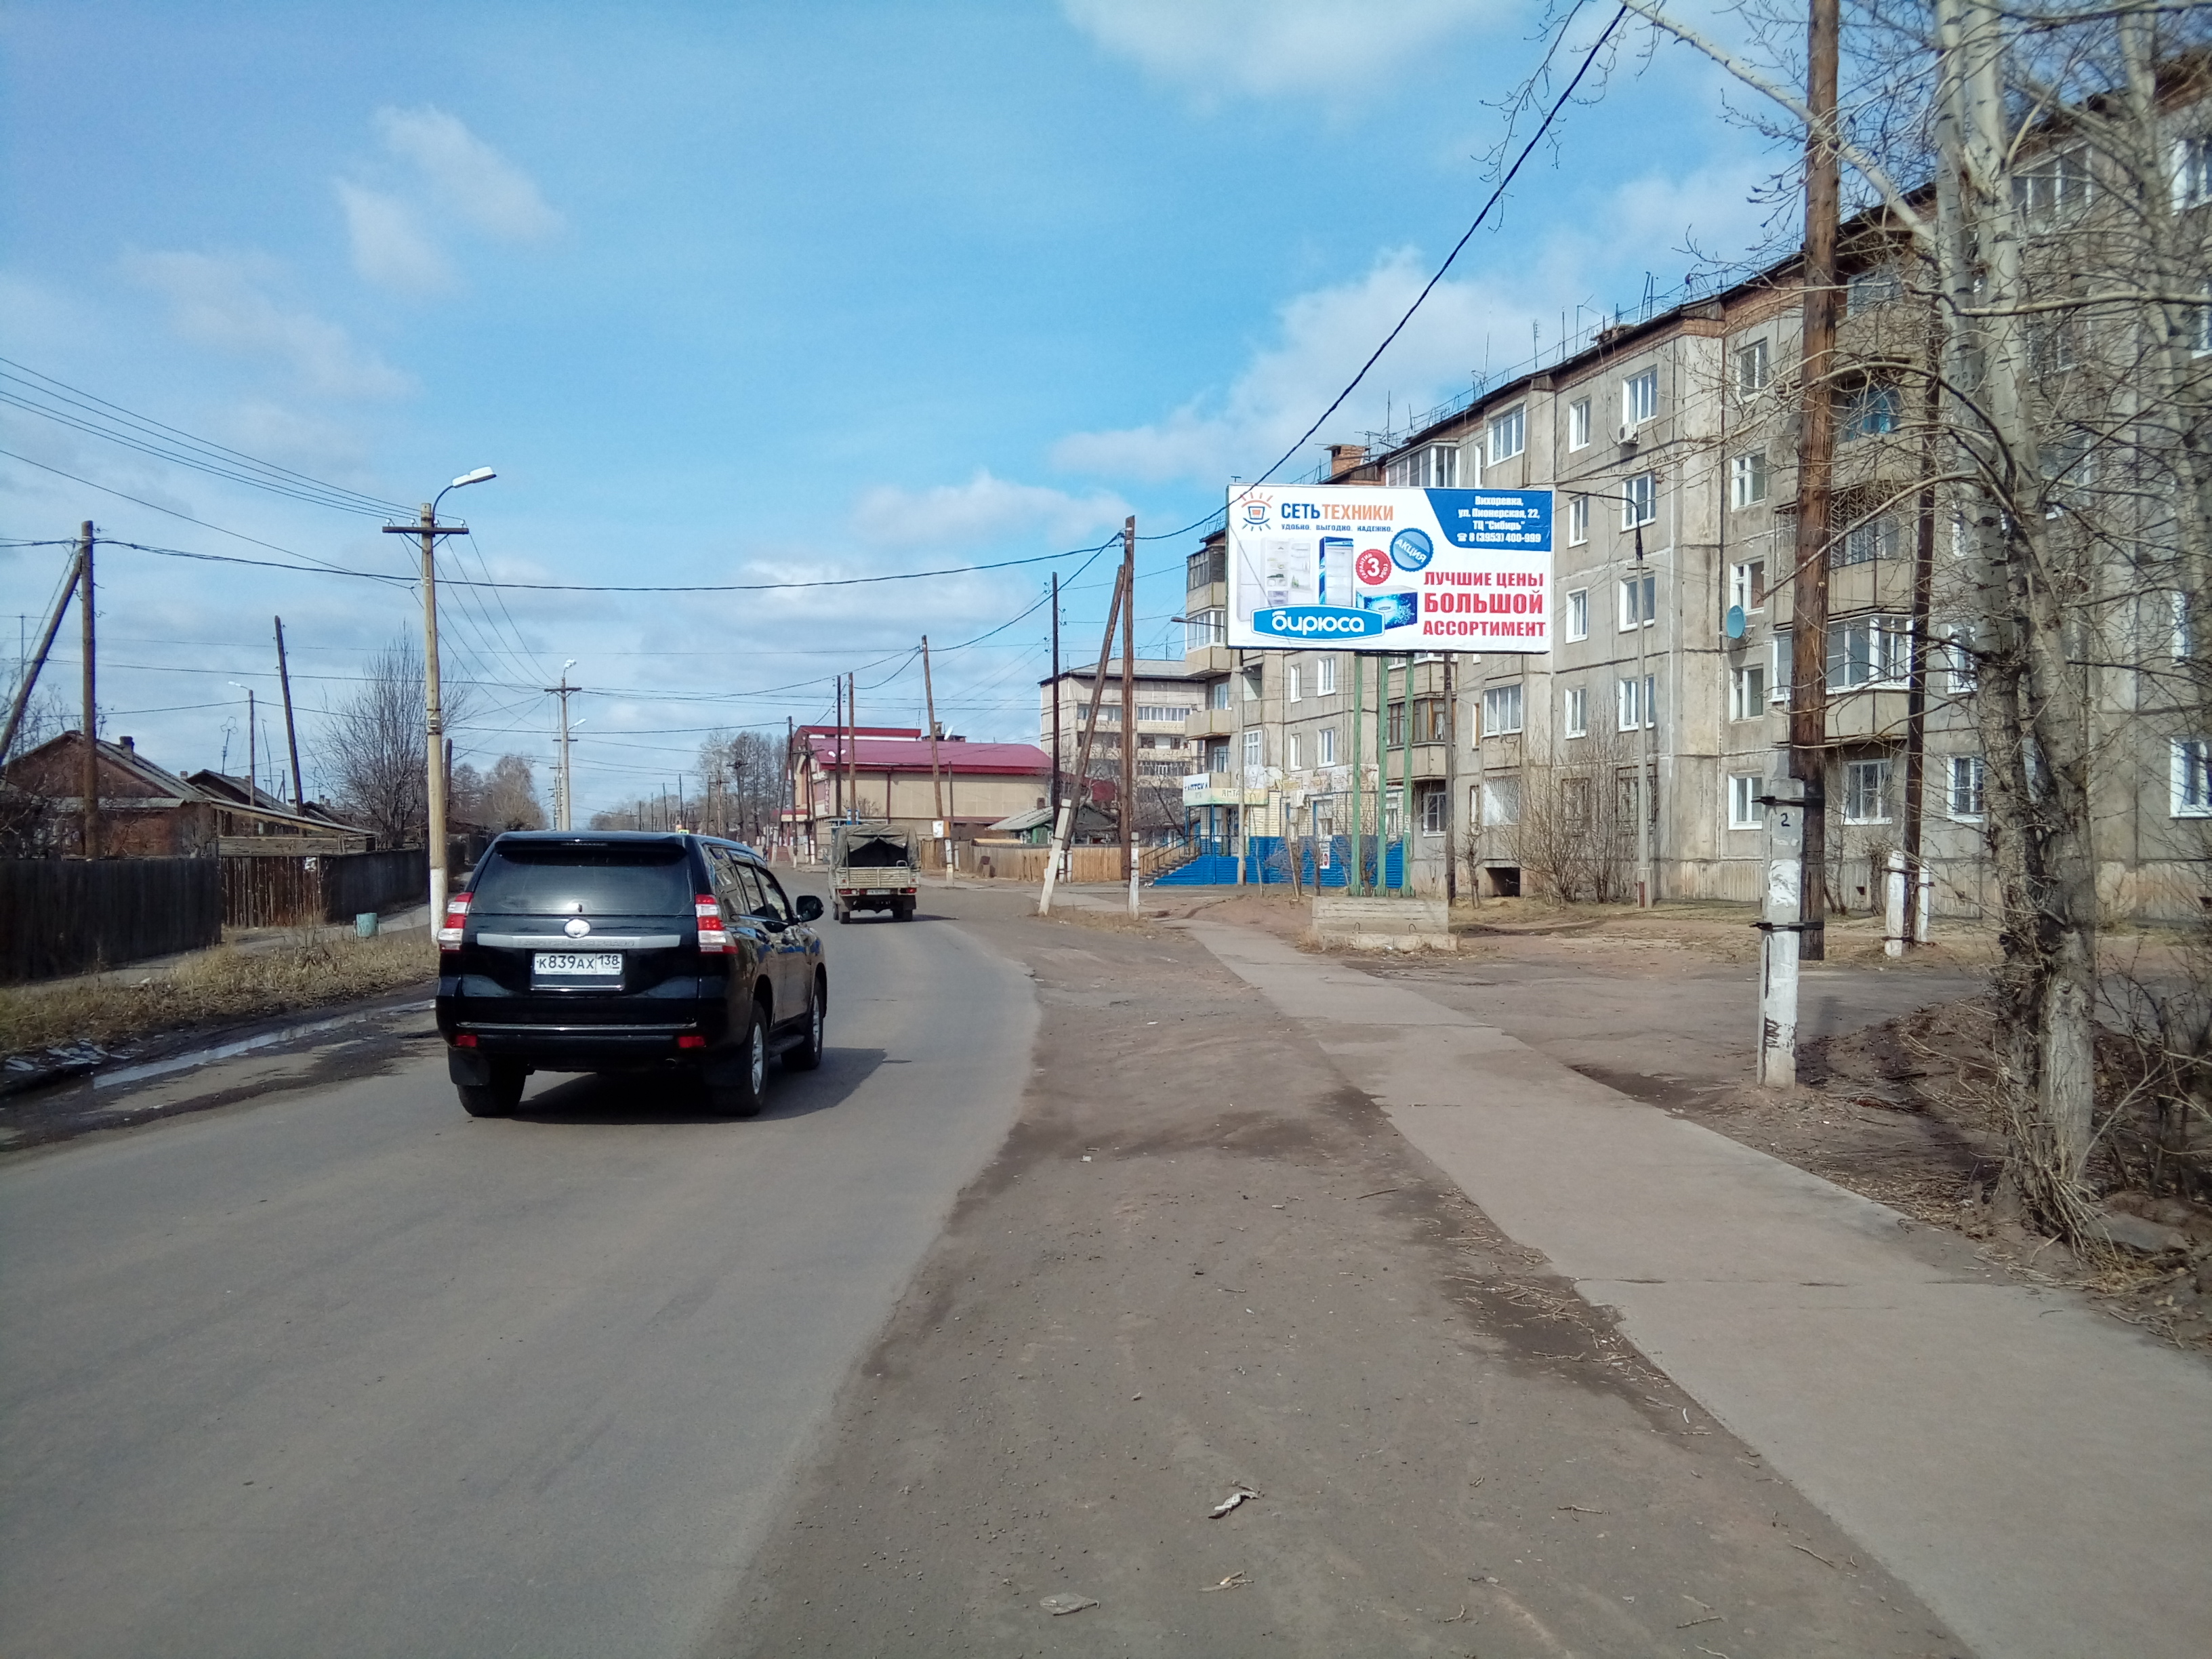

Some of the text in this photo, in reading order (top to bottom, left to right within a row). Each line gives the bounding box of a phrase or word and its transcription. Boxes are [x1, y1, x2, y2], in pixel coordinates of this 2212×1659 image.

[1475, 495, 1523, 506] Вихоревка,
[1281, 503, 1393, 520] СЕТЬ ТЕХНИКИ
[1458, 508, 1540, 518] ул. Пионерская, 22,
[1473, 520, 1484, 531] ТЦ
[1469, 533, 1541, 543] 8 (3953) 400-999
[1395, 539, 1427, 563] АКЦИЯ
[1367, 557, 1380, 577] 3
[1423, 571, 1544, 588] ЛУЧШИЕ ЦЕНЫ
[1424, 589, 1543, 614] БОЛЬШОЙ
[1271, 611, 1364, 635] бирюса
[1422, 620, 1546, 636] АССОРТИМЕНТ
[1780, 813, 1791, 827] 2
[597, 955, 618, 965] 138
